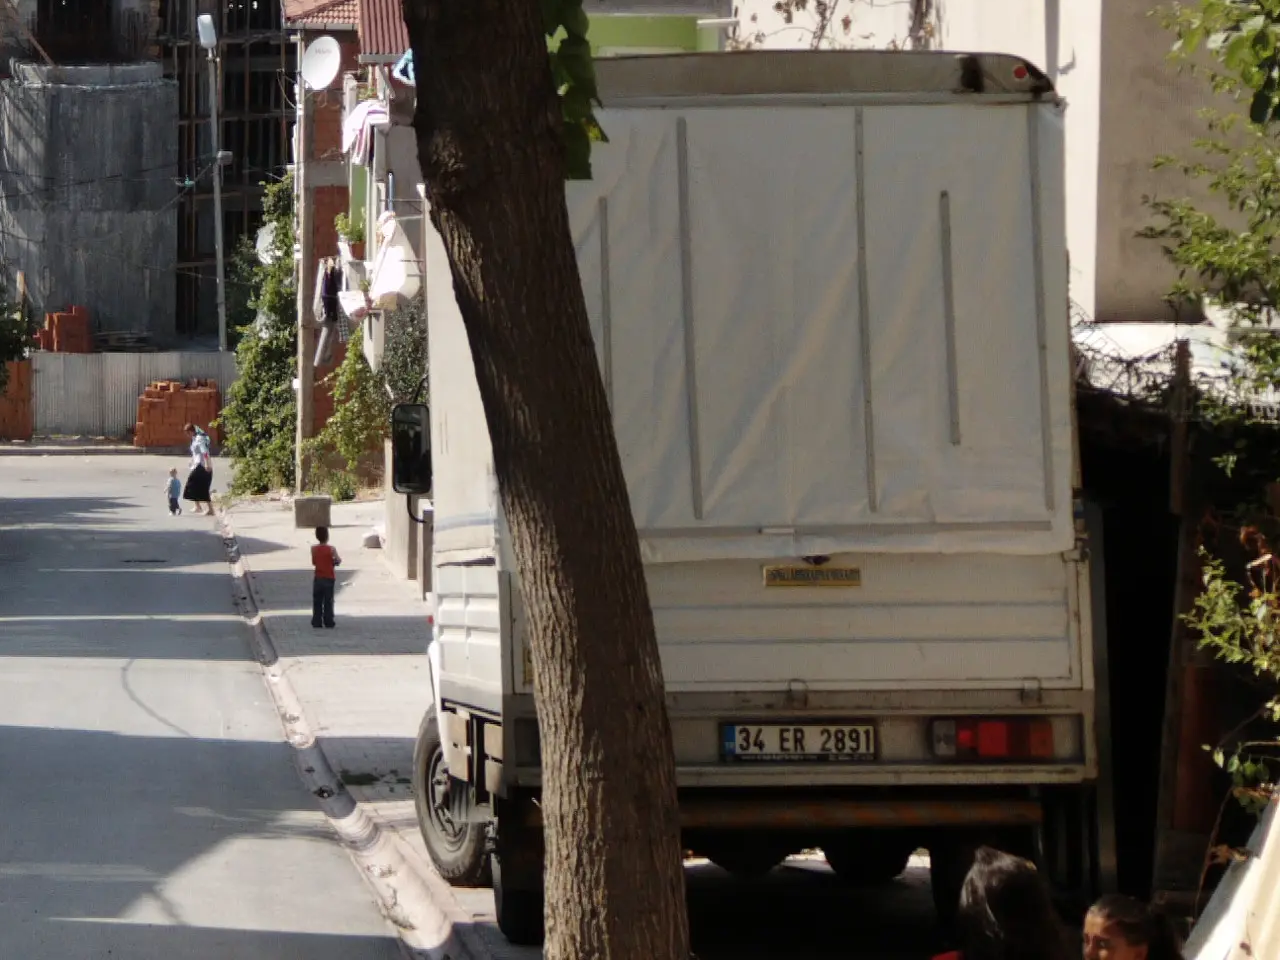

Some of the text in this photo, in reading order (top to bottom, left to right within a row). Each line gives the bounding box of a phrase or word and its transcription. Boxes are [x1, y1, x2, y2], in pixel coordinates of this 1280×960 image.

[738, 727, 871, 752] 34 ER 2891
